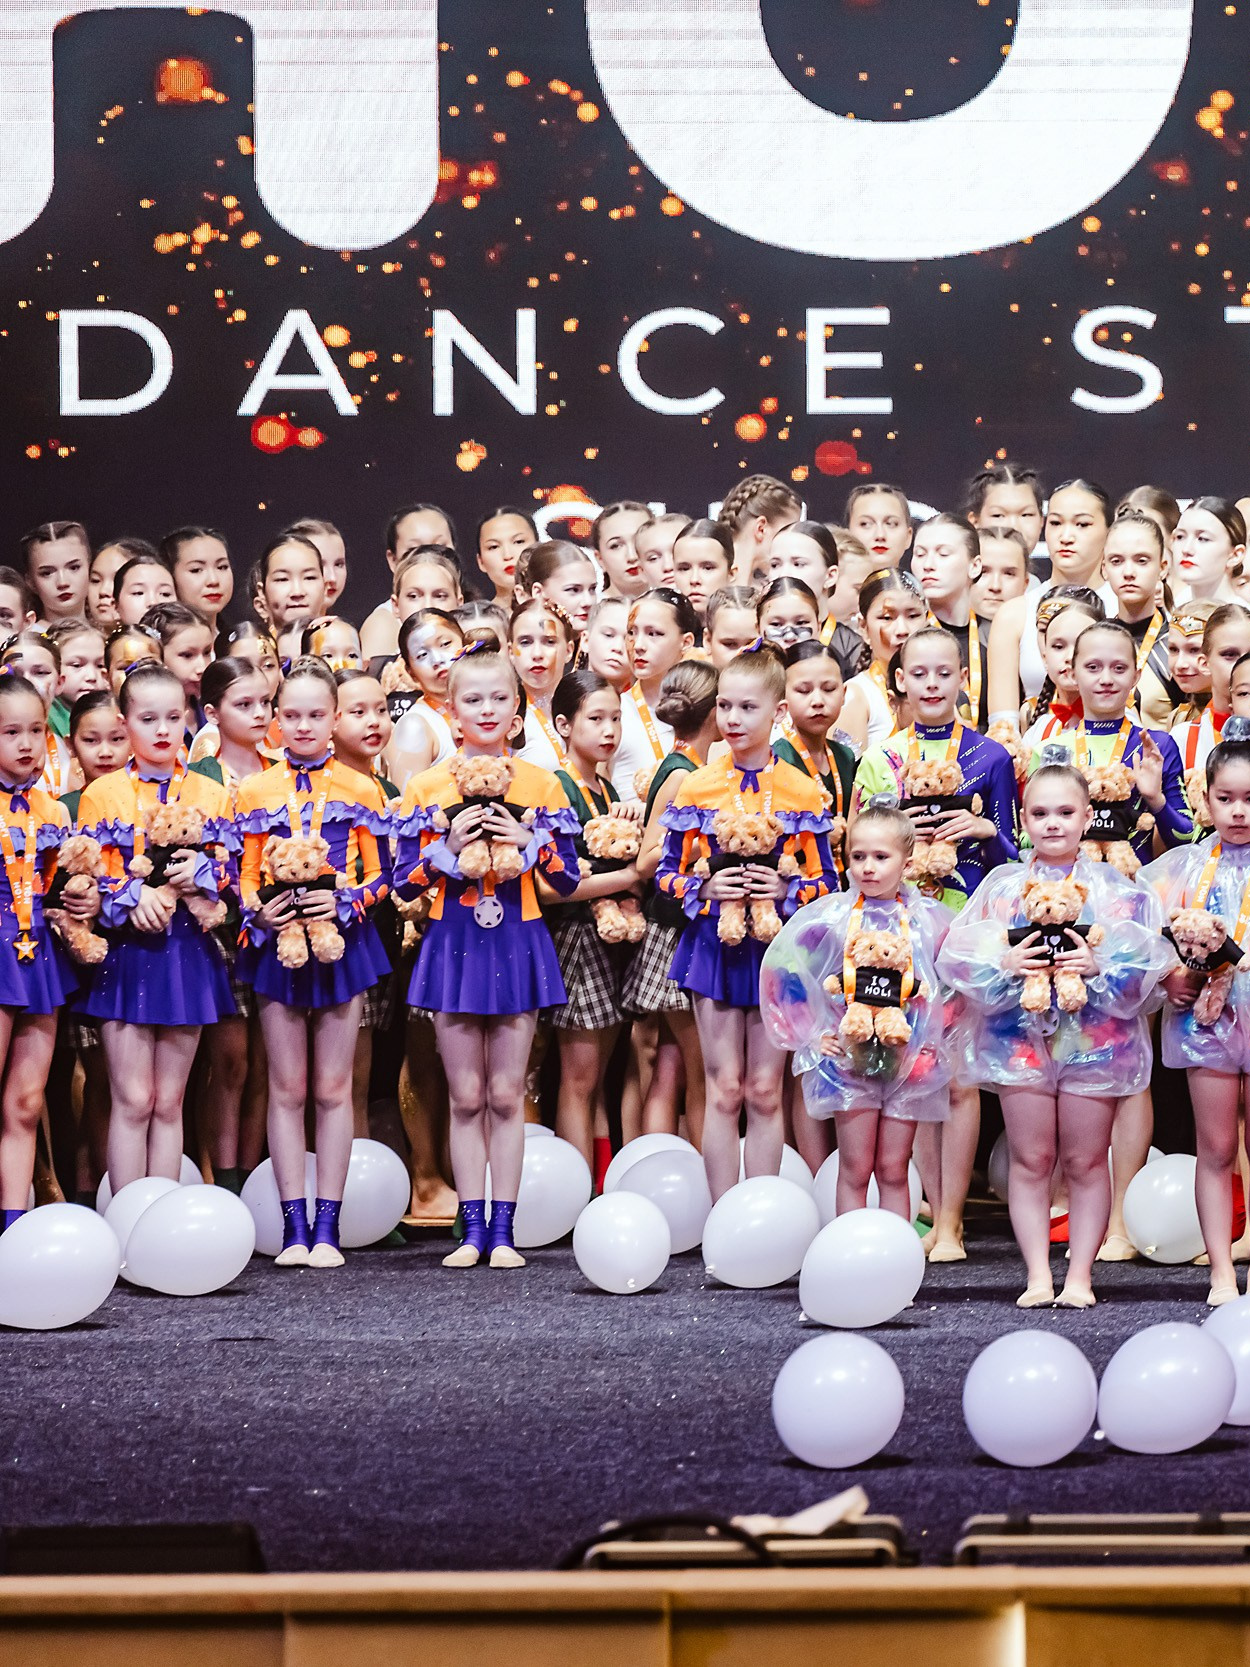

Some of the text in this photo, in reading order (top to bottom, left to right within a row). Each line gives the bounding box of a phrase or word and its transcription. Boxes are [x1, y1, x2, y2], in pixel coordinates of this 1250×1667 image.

[58, 306, 894, 416] DANCE
[871, 975, 877, 986] I
[864, 986, 891, 998] HOLI
